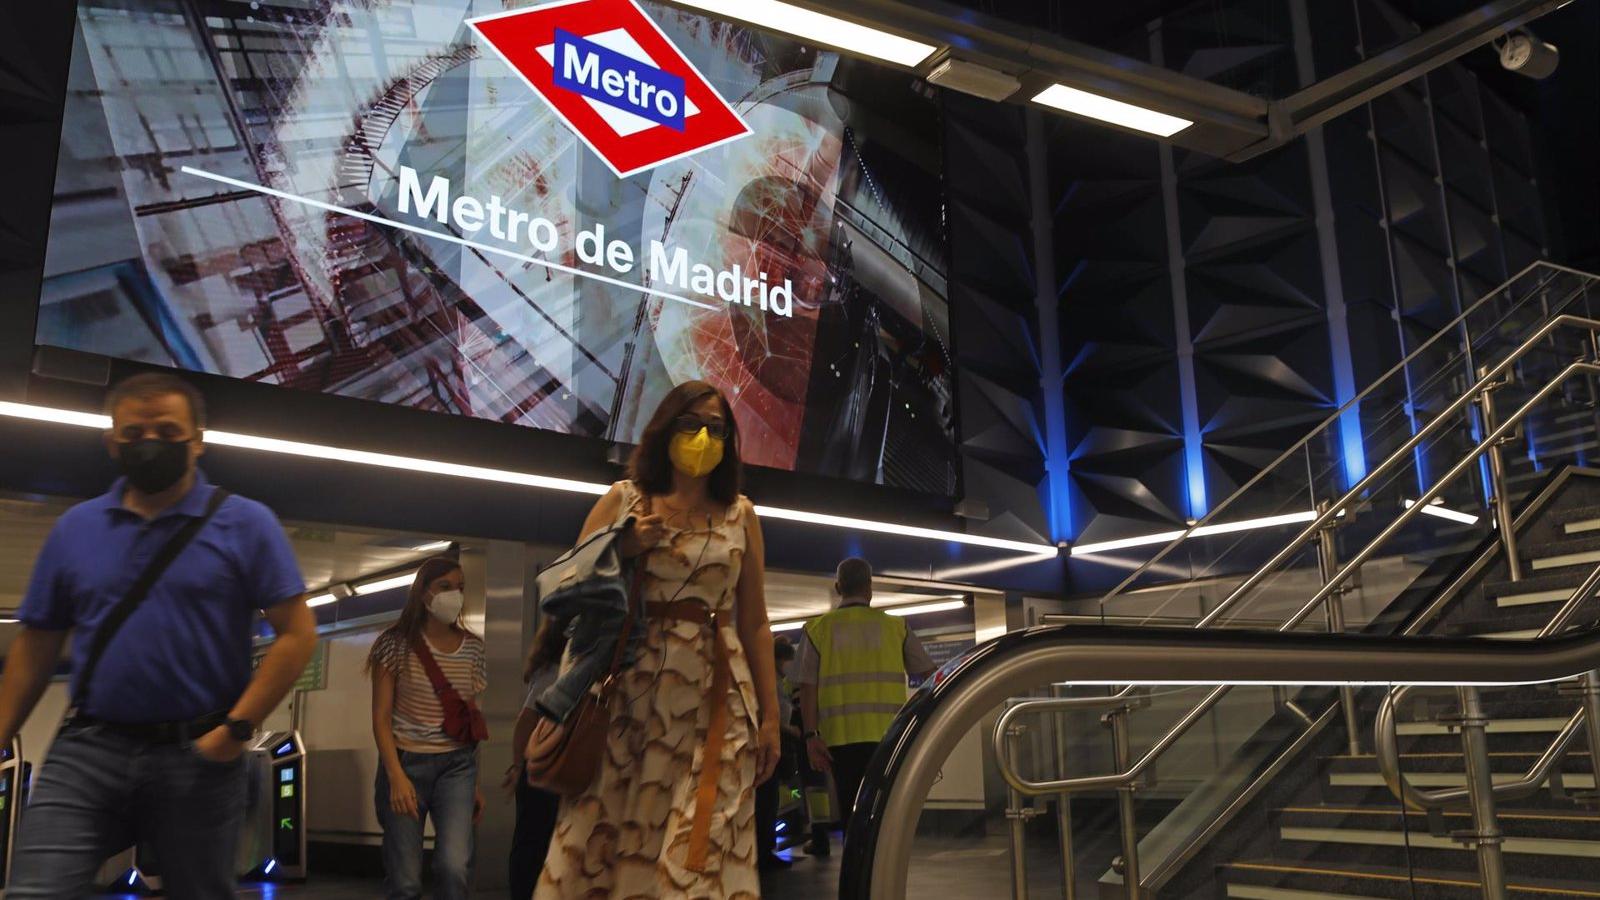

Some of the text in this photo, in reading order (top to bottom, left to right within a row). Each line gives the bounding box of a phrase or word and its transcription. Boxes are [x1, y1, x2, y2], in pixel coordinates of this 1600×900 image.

[563, 43, 678, 118] Metro
[398, 165, 793, 318] Metro de Madrid
